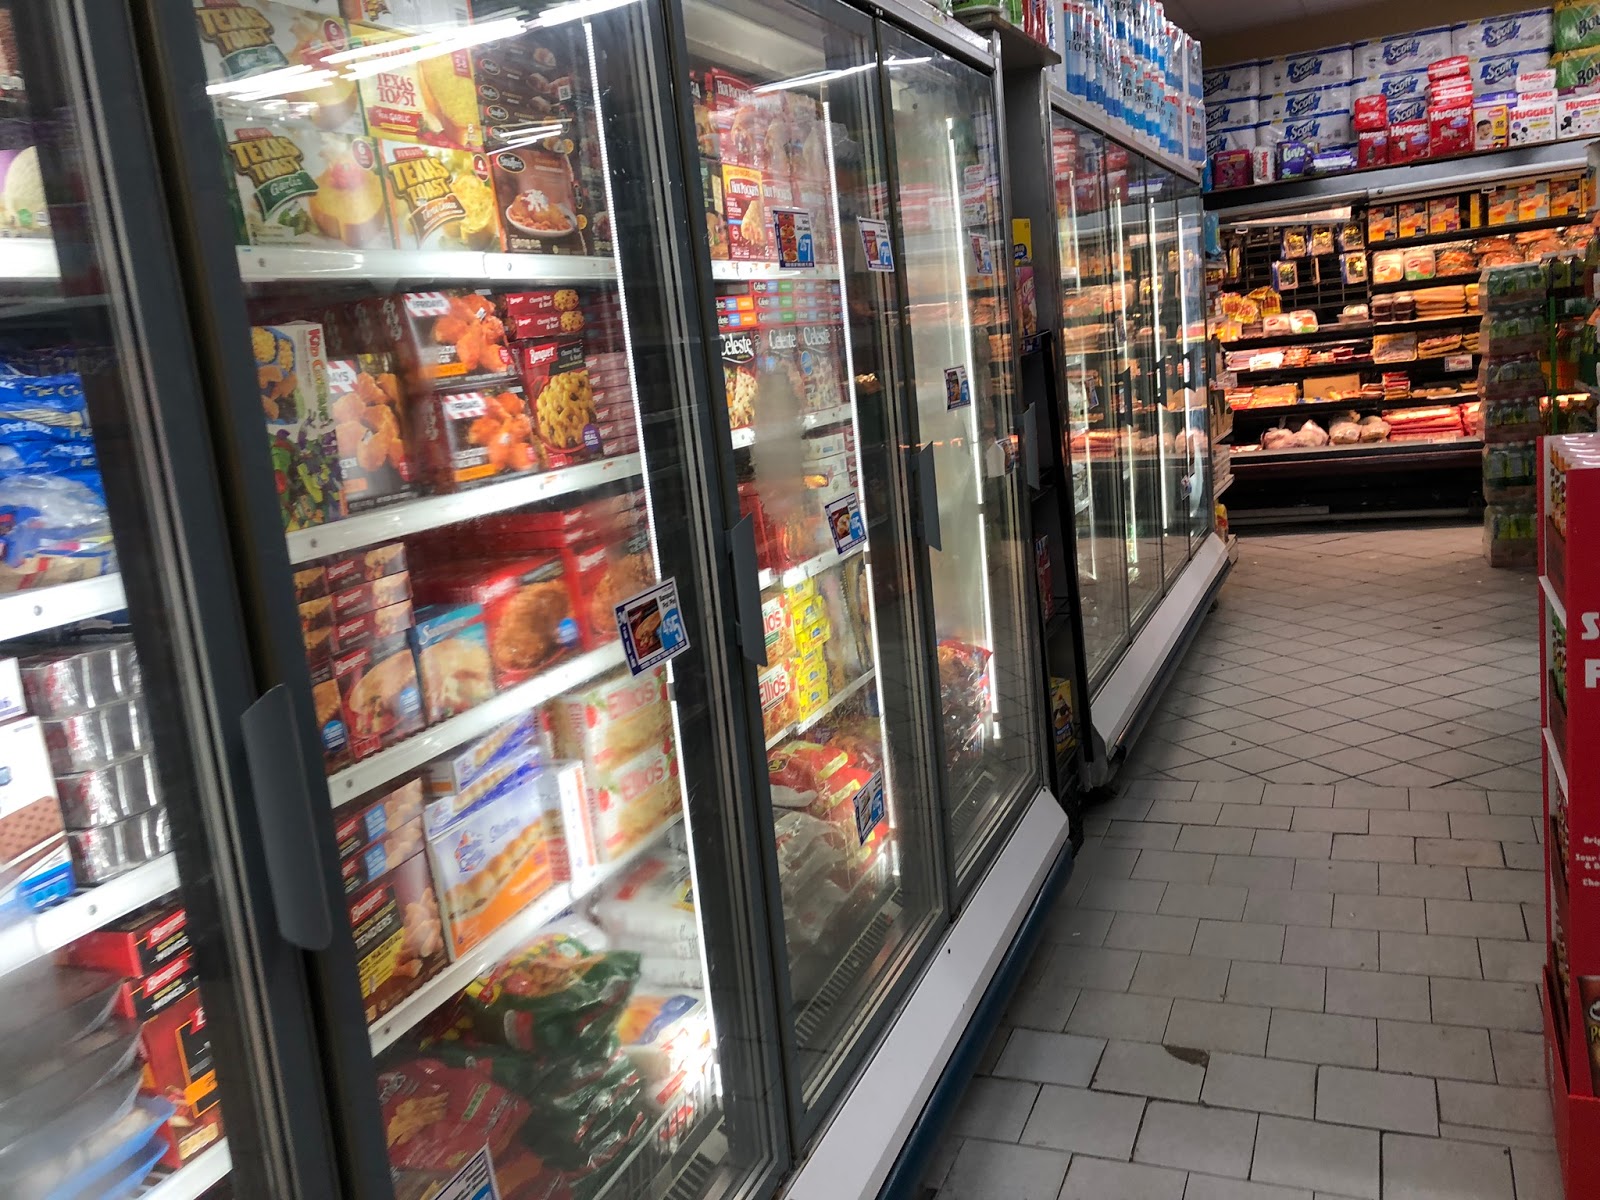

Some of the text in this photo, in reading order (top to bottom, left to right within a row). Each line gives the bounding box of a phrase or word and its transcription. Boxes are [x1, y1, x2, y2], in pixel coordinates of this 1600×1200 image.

[196, 7, 270, 36] TEXAS
[1293, 57, 1318, 79] Scott
[1486, 58, 1515, 79] Scott
[377, 72, 414, 92] TEXAS
[1387, 75, 1415, 95] Scott
[377, 88, 416, 107] TOAST
[1291, 93, 1316, 113] Scott
[1430, 107, 1472, 121] HUGGIES
[1510, 107, 1554, 121] HUGGIES
[1390, 123, 1428, 137] HUGGIE
[229, 137, 301, 168] TEXAS
[1283, 147, 1305, 162] Luvs
[251, 157, 300, 183] TOAST
[388, 158, 450, 191] TEXAS
[477, 160, 484, 170] 4
[407, 178, 450, 206] TOAST
[308, 328, 320, 358] KID
[769, 329, 797, 349] Celeste
[803, 327, 831, 346] Celeste
[530, 346, 555, 365] Banquet
